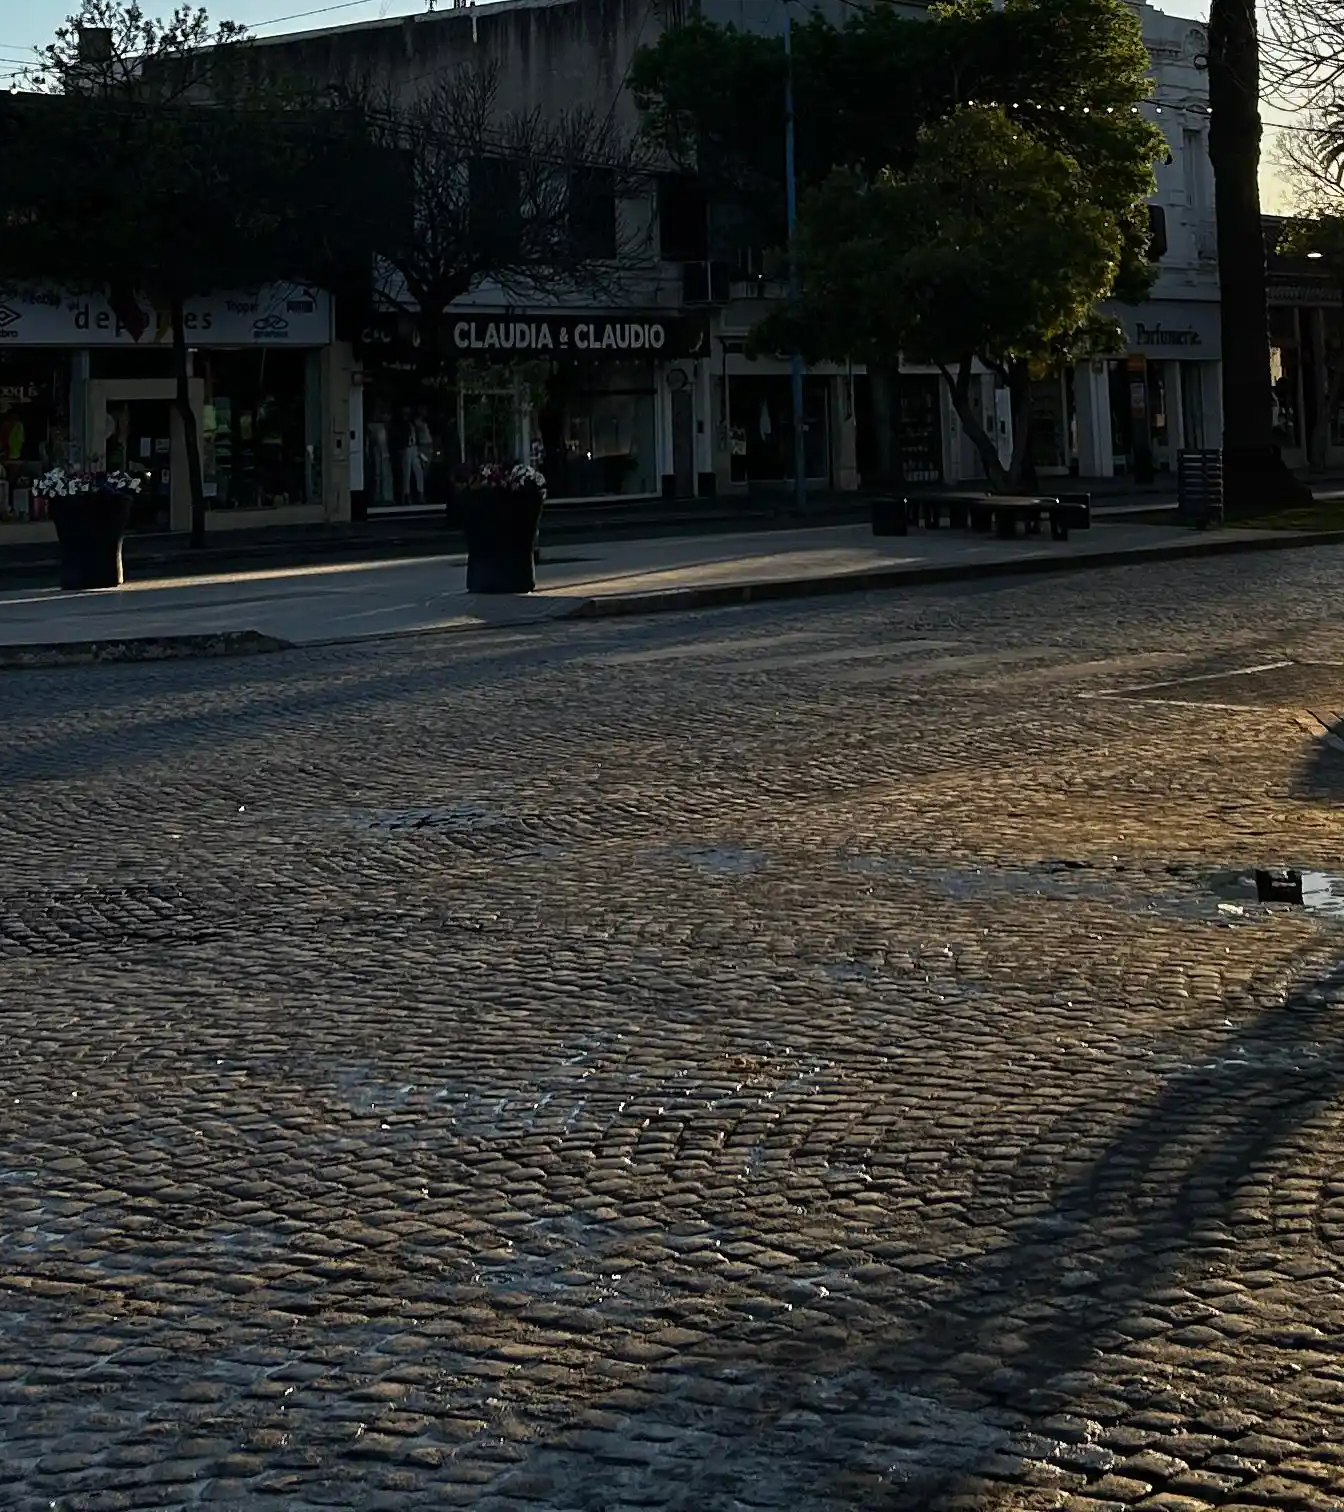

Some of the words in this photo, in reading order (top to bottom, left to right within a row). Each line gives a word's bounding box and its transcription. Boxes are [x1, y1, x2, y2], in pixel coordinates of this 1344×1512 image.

[453, 321, 554, 349] CLAUDIA
[559, 326, 569, 349] &
[573, 323, 666, 349] CLAUDIO
